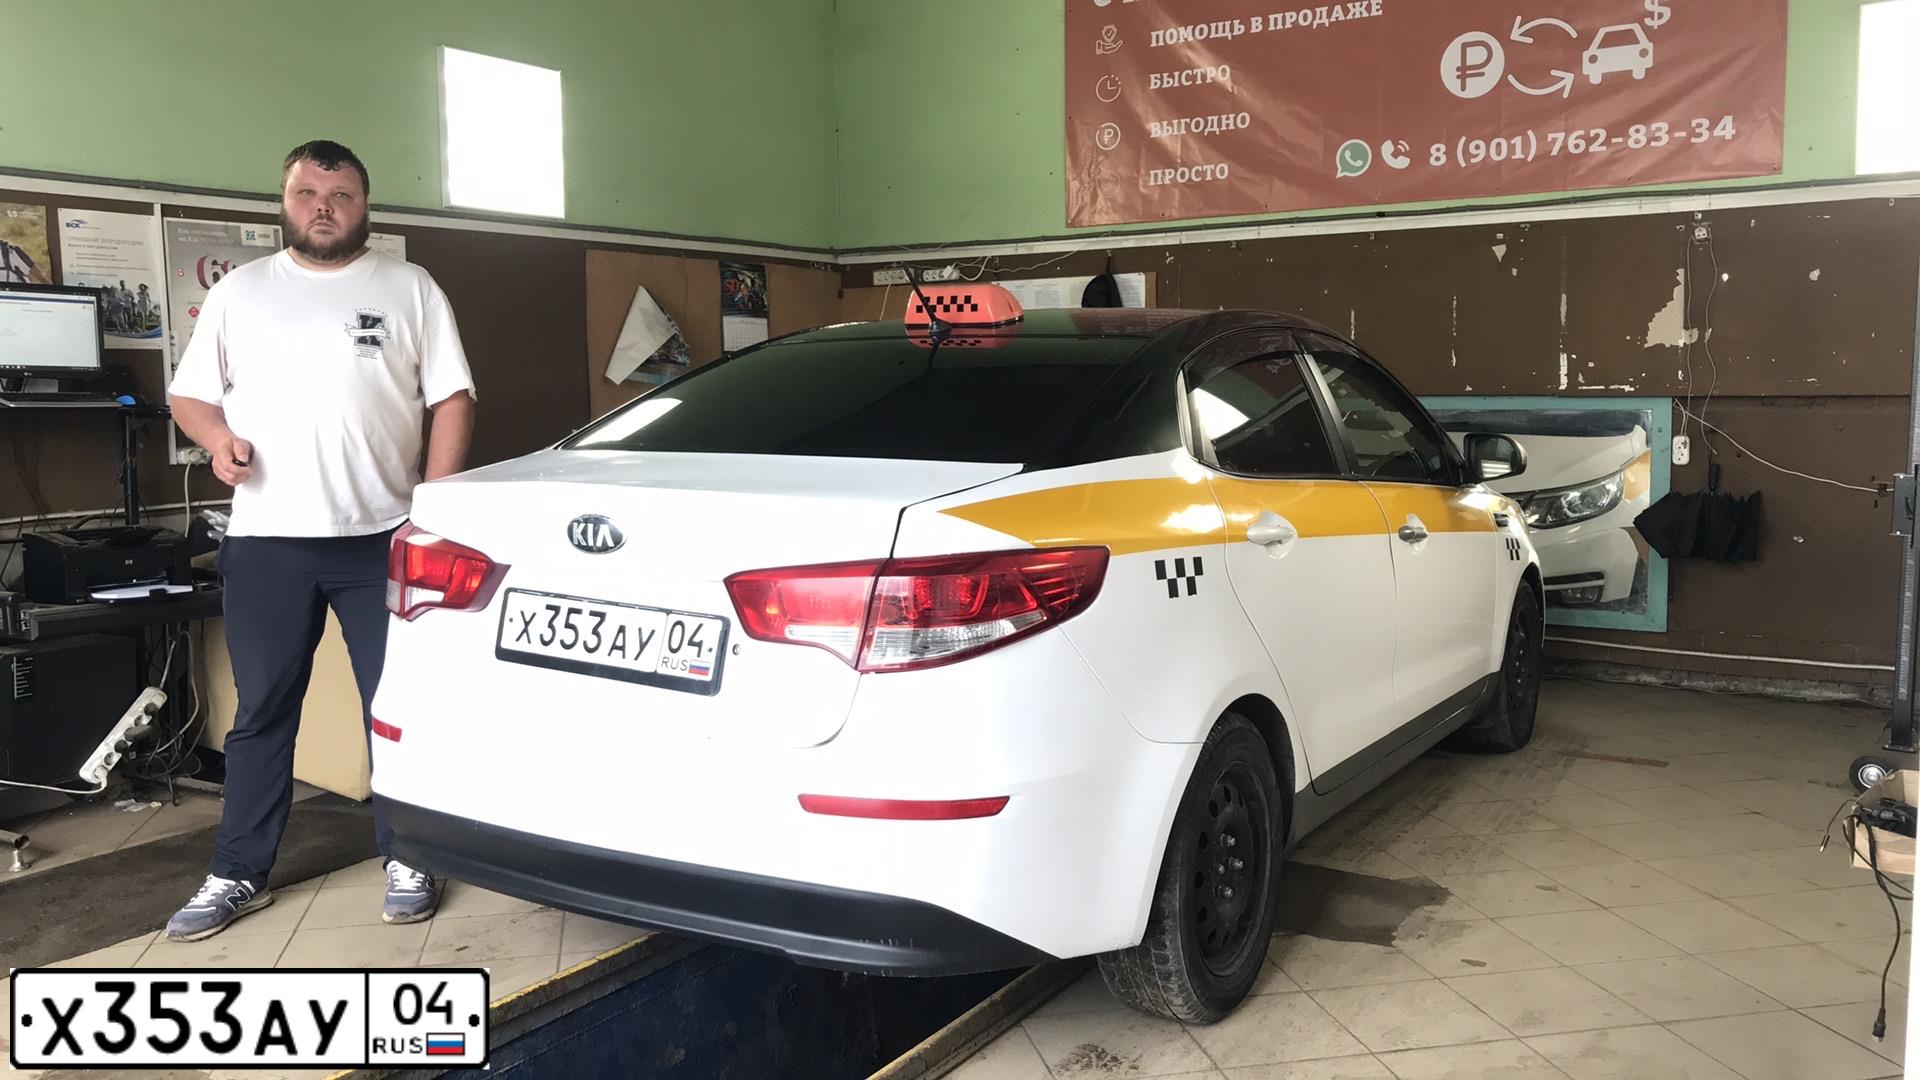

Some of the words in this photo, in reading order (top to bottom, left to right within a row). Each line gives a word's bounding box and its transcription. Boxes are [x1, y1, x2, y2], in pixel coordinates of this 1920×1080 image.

[1150, 19, 1245, 47] ПОМОЩЬ
[1250, 16, 1263, 33] В
[1268, 0, 1383, 31] ПРОДАЖЕ
[1149, 65, 1231, 90] БЫСТРО
[1149, 112, 1251, 138] ВЫГОДНО
[1428, 143, 1447, 167] 8
[1456, 130, 1537, 168] (901)
[1547, 115, 1737, 157] 762-83-34
[1148, 163, 1230, 186] ПРОСТО
[572, 522, 615, 548] KIA
[667, 620, 704, 657] 04
[661, 656, 688, 671] RUS
